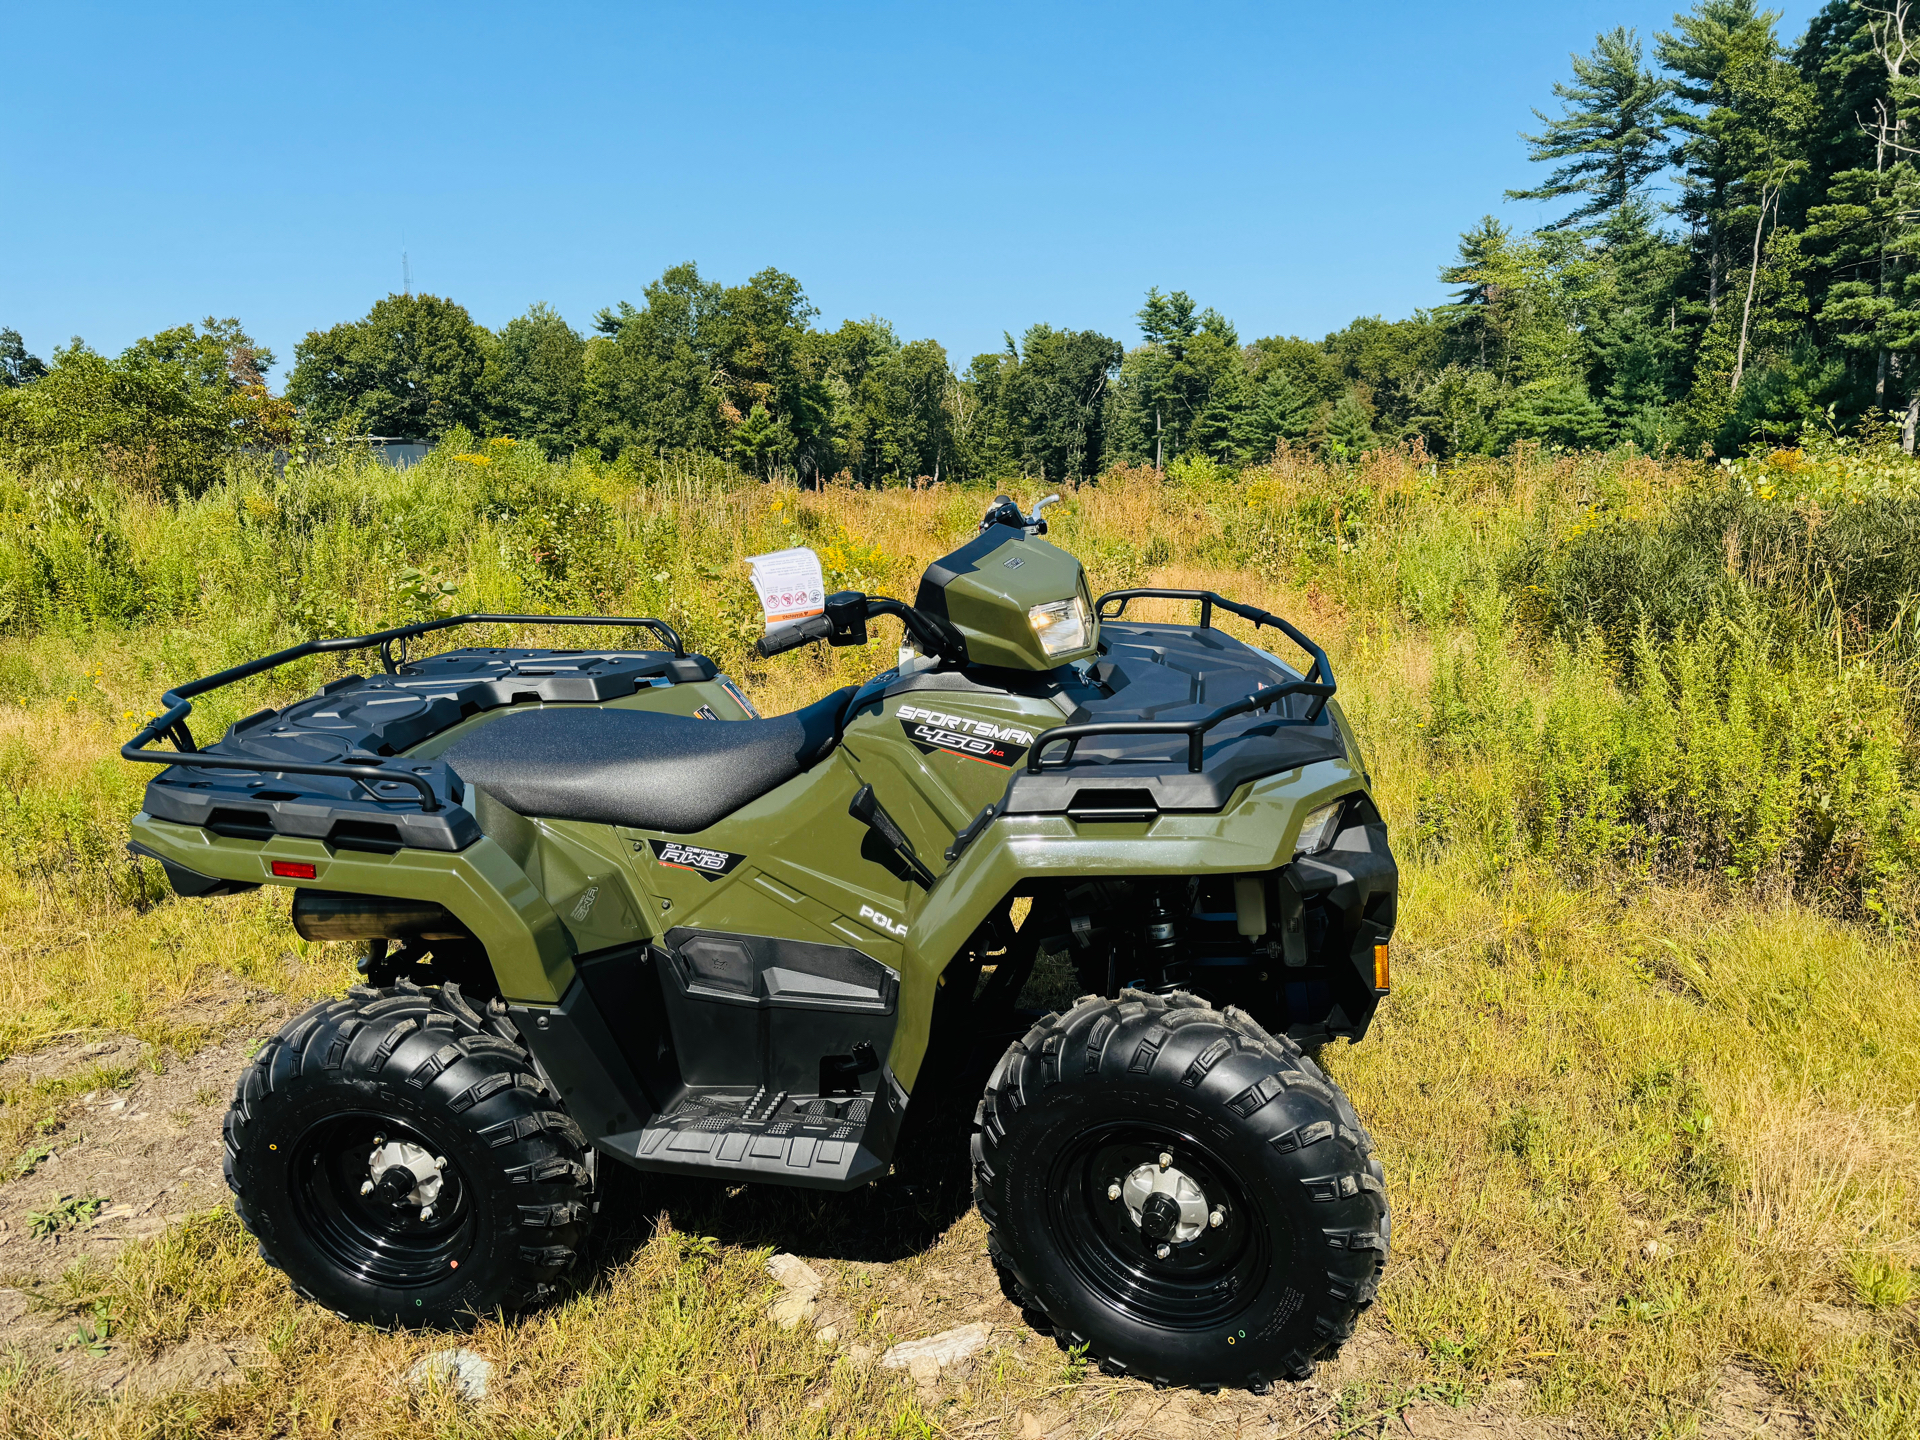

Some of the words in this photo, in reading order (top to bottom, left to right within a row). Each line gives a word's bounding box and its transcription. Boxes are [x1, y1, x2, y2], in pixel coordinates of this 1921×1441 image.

[895, 705, 1035, 745] SPORTSMAN
[914, 725, 994, 754] 450
[660, 849, 726, 869] AWD
